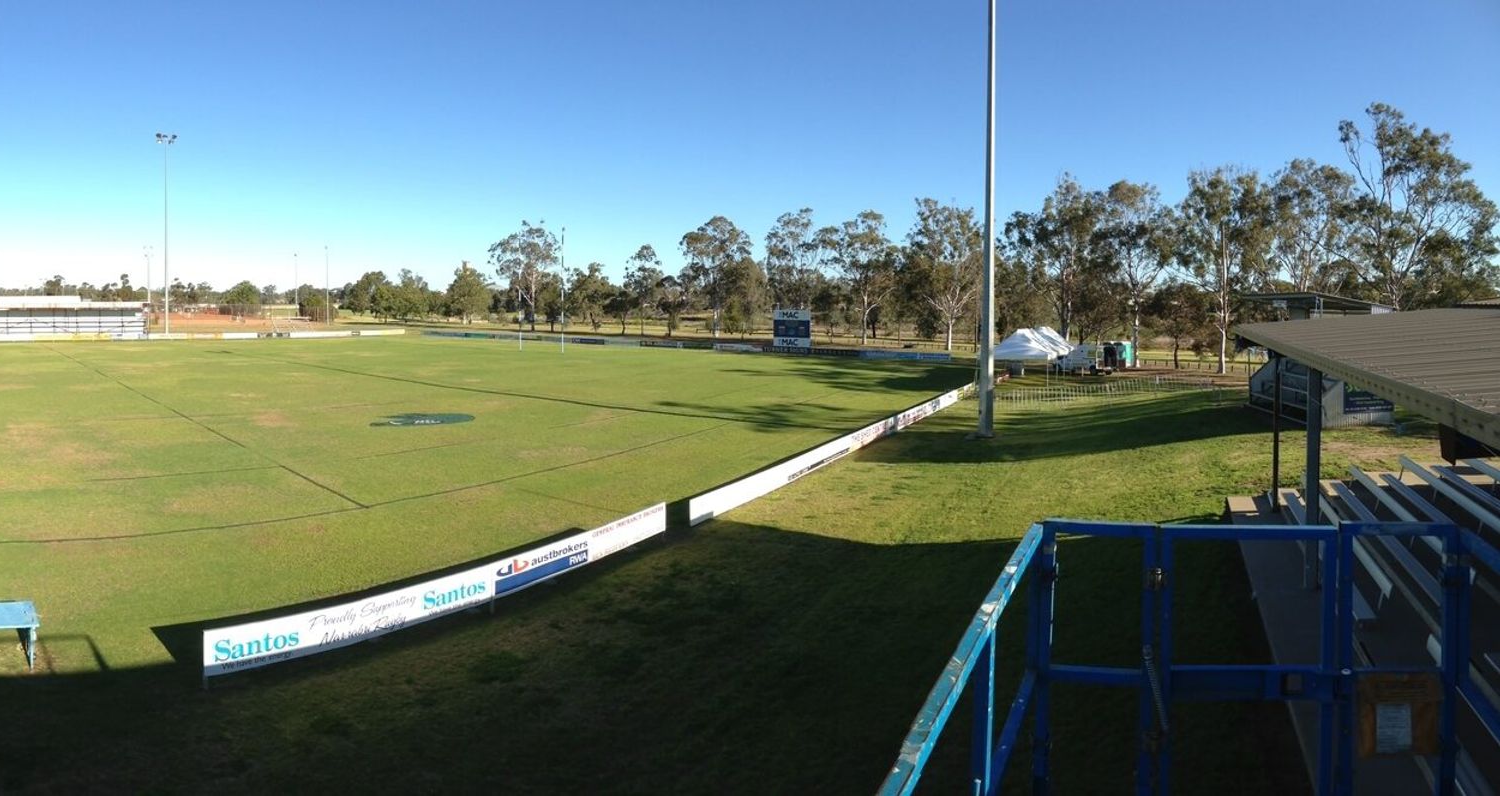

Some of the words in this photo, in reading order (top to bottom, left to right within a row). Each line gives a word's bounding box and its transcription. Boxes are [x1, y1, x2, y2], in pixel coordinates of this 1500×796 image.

[530, 539, 589, 567] austbrokers
[423, 579, 486, 610] Santos
[308, 609, 357, 631] Proudly
[359, 595, 417, 619] Supporting
[213, 630, 299, 663] Santos
[221, 661, 235, 671] We
[235, 657, 252, 669] have
[253, 654, 268, 664] the
